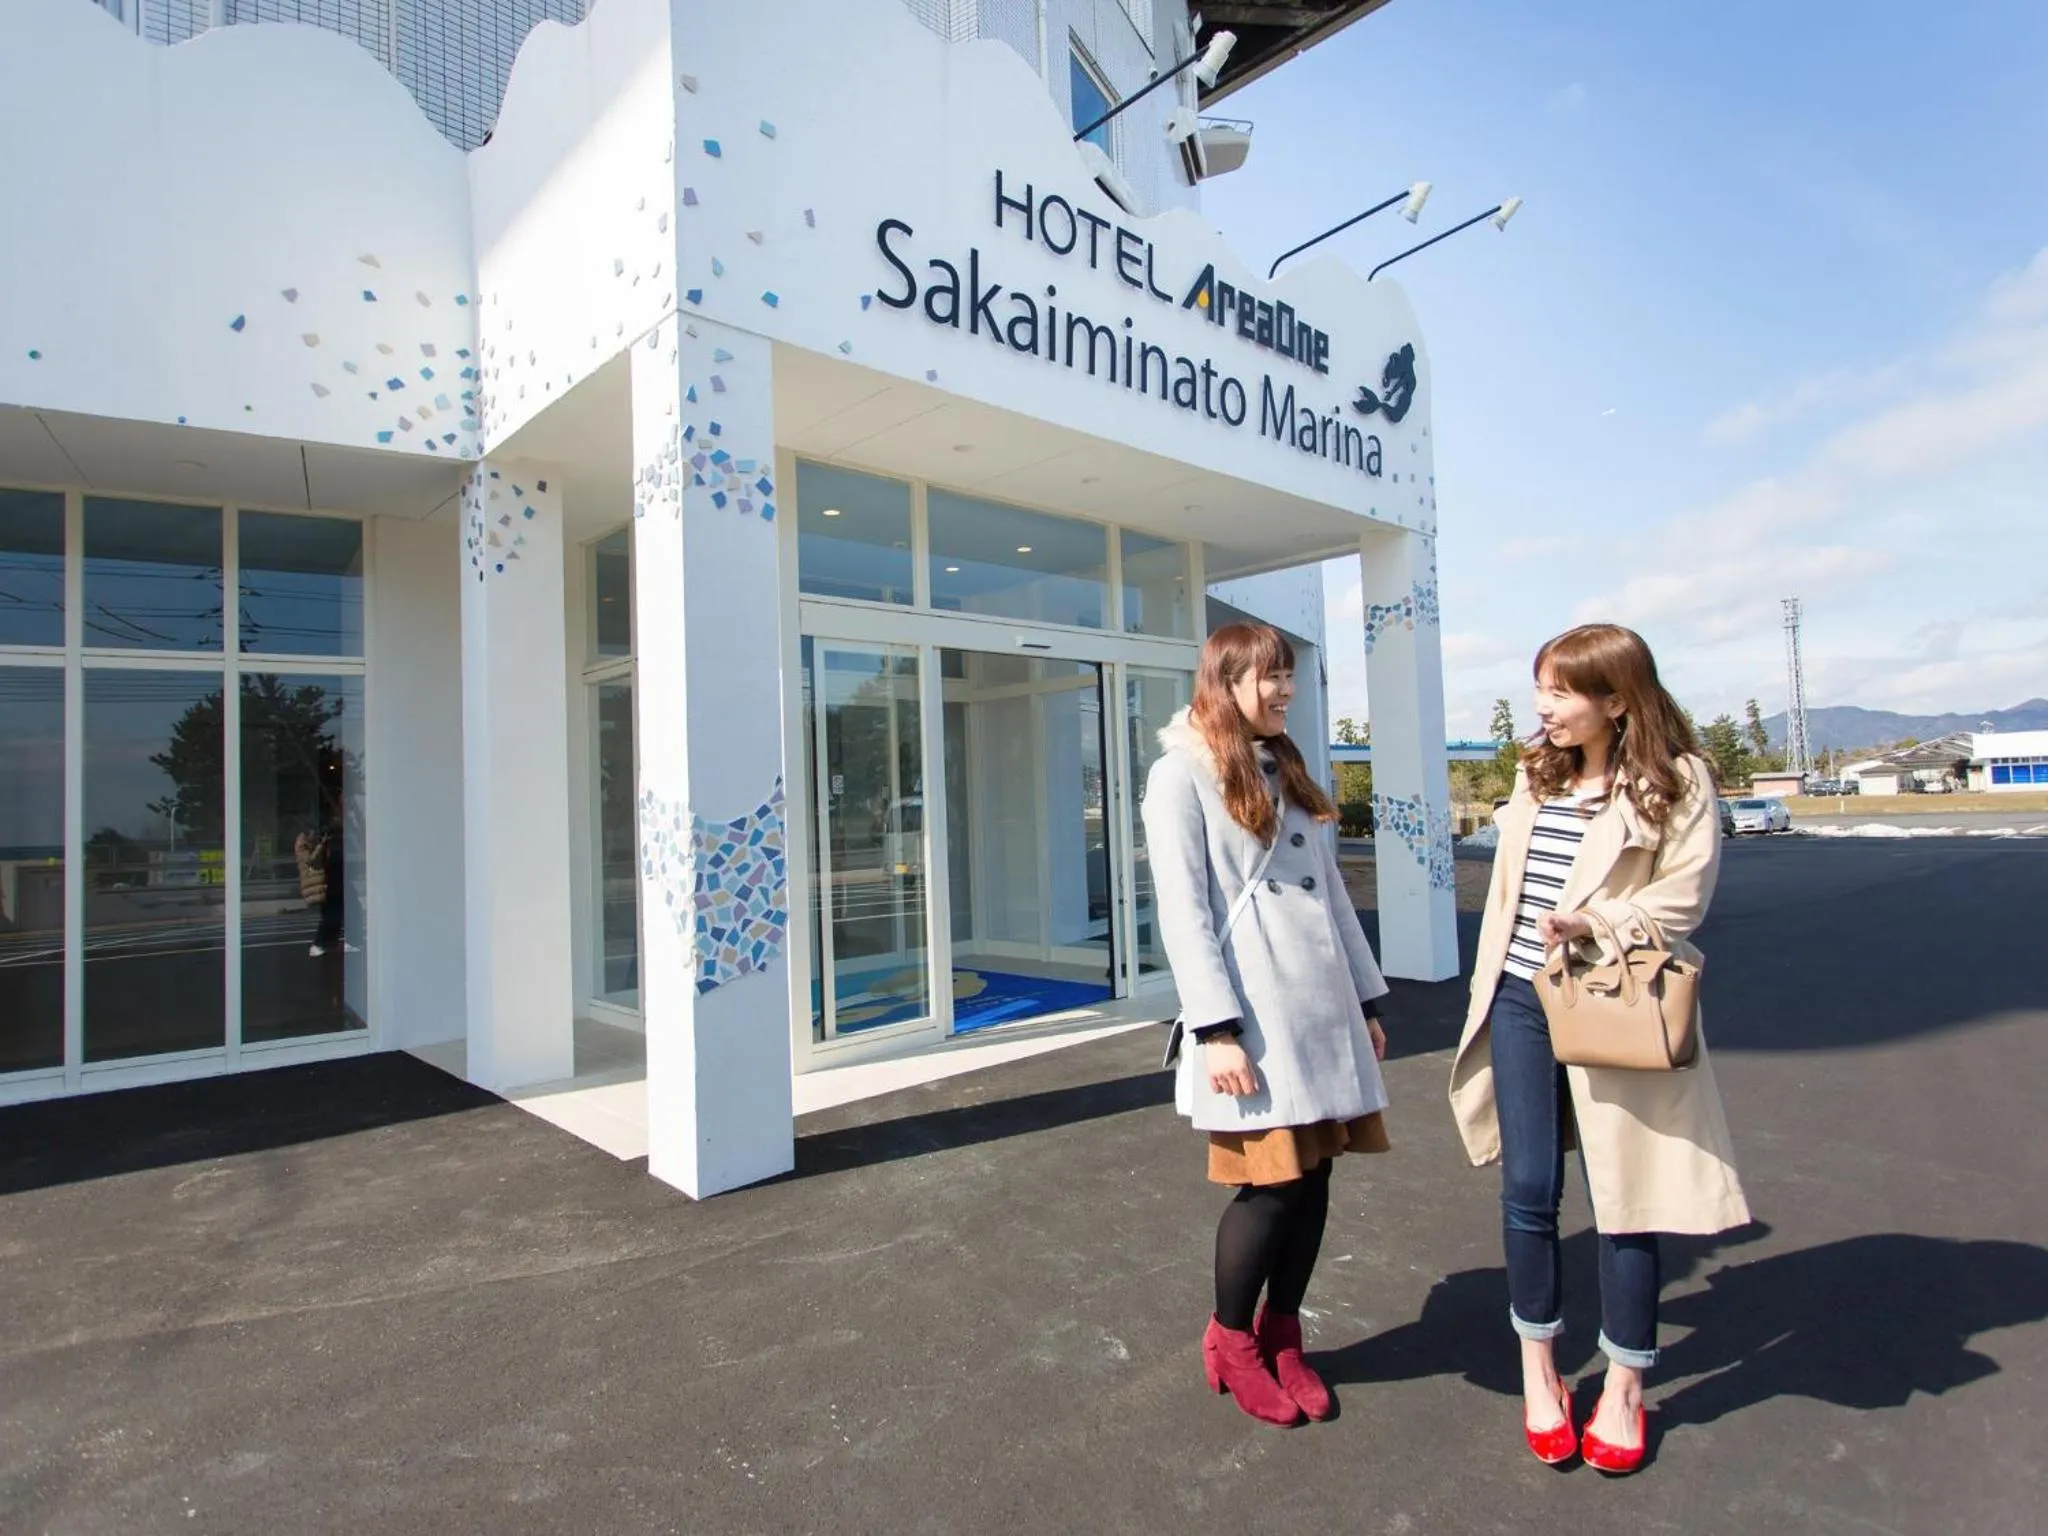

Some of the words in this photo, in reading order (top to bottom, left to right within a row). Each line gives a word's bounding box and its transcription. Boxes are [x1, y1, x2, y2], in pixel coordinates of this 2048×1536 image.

[875, 218, 1247, 427] Sakaiminato
[1260, 374, 1383, 478] Marina
[994, 168, 1174, 304] HOTEL
[1181, 262, 1329, 375] AreaOne
